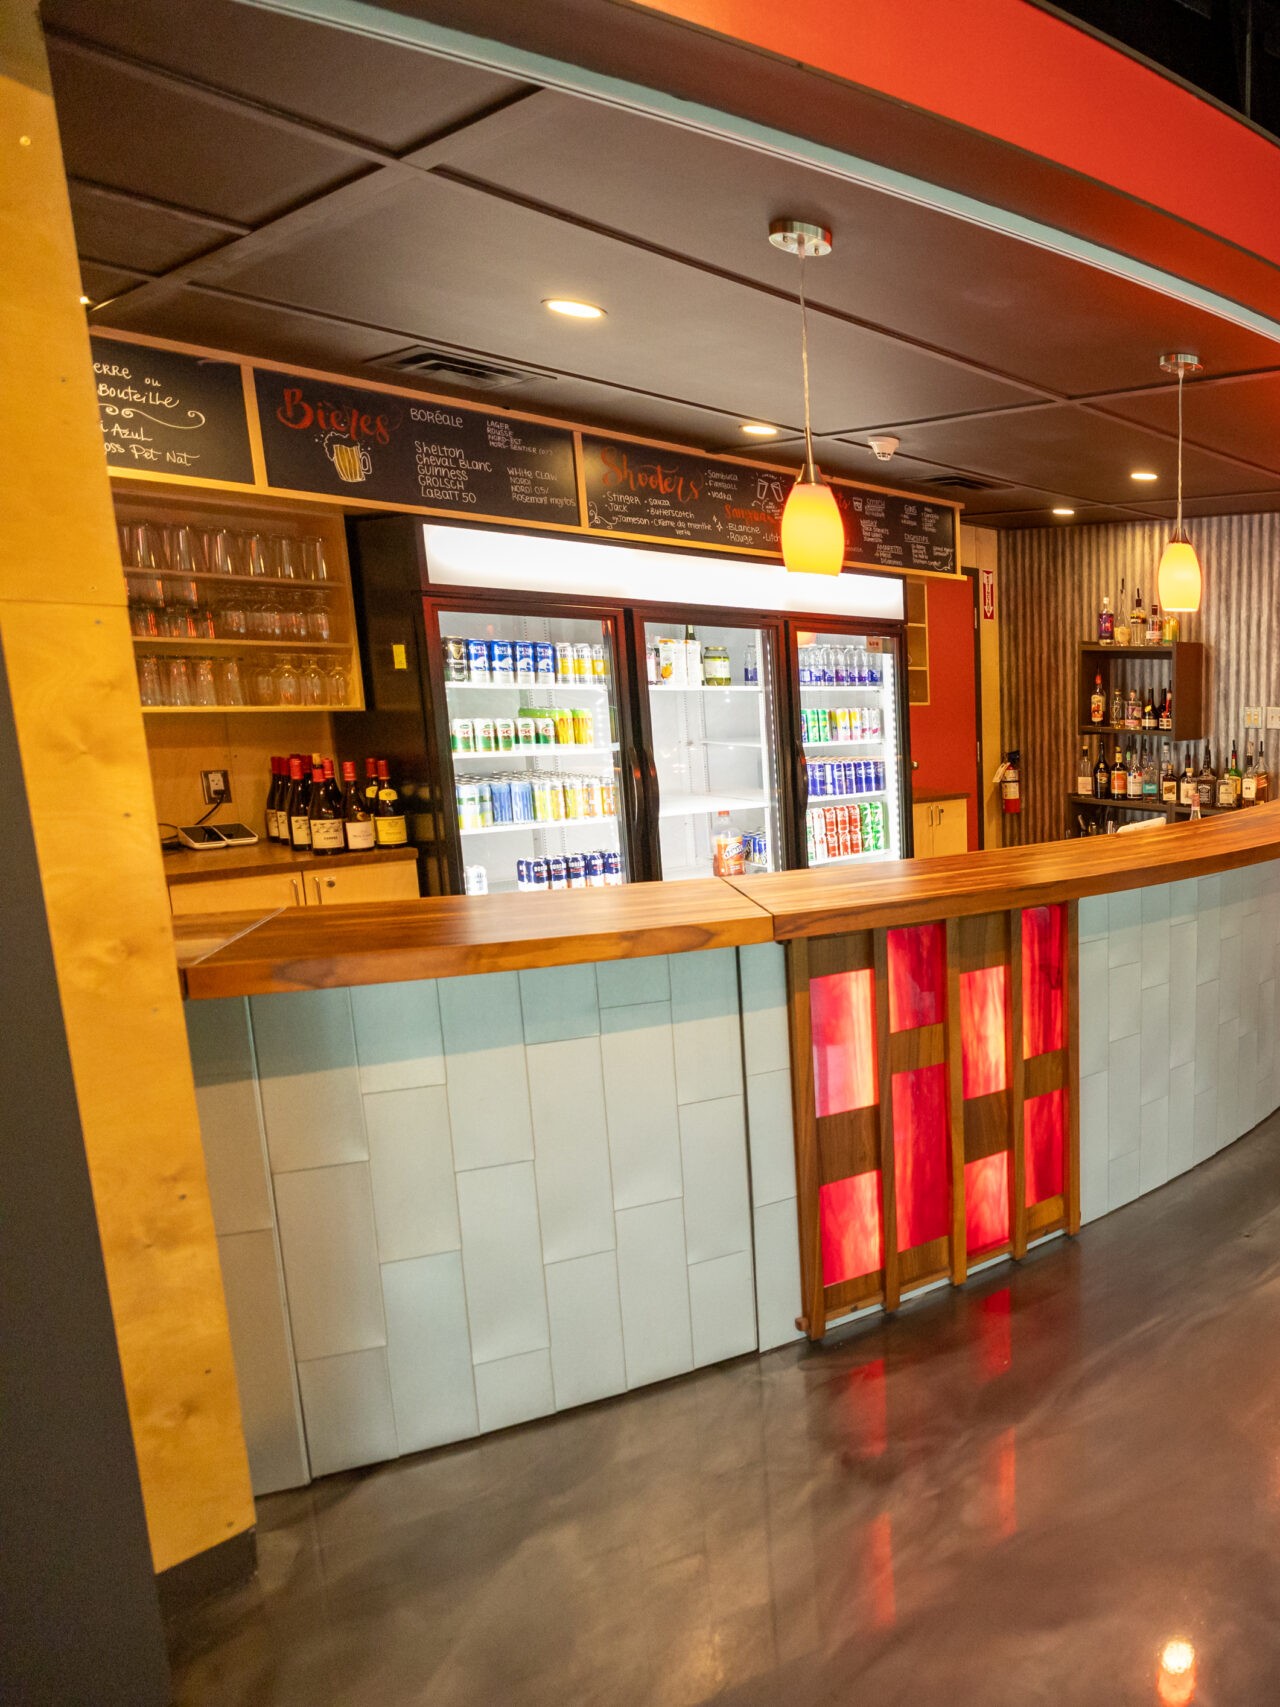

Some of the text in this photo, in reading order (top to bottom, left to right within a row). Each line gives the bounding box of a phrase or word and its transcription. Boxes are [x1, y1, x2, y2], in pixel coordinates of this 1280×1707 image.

[145, 377, 161, 387] ou
[601, 447, 700, 503] Shooters
[418, 474, 465, 490] GROLSCH
[462, 492, 477, 503] 50
